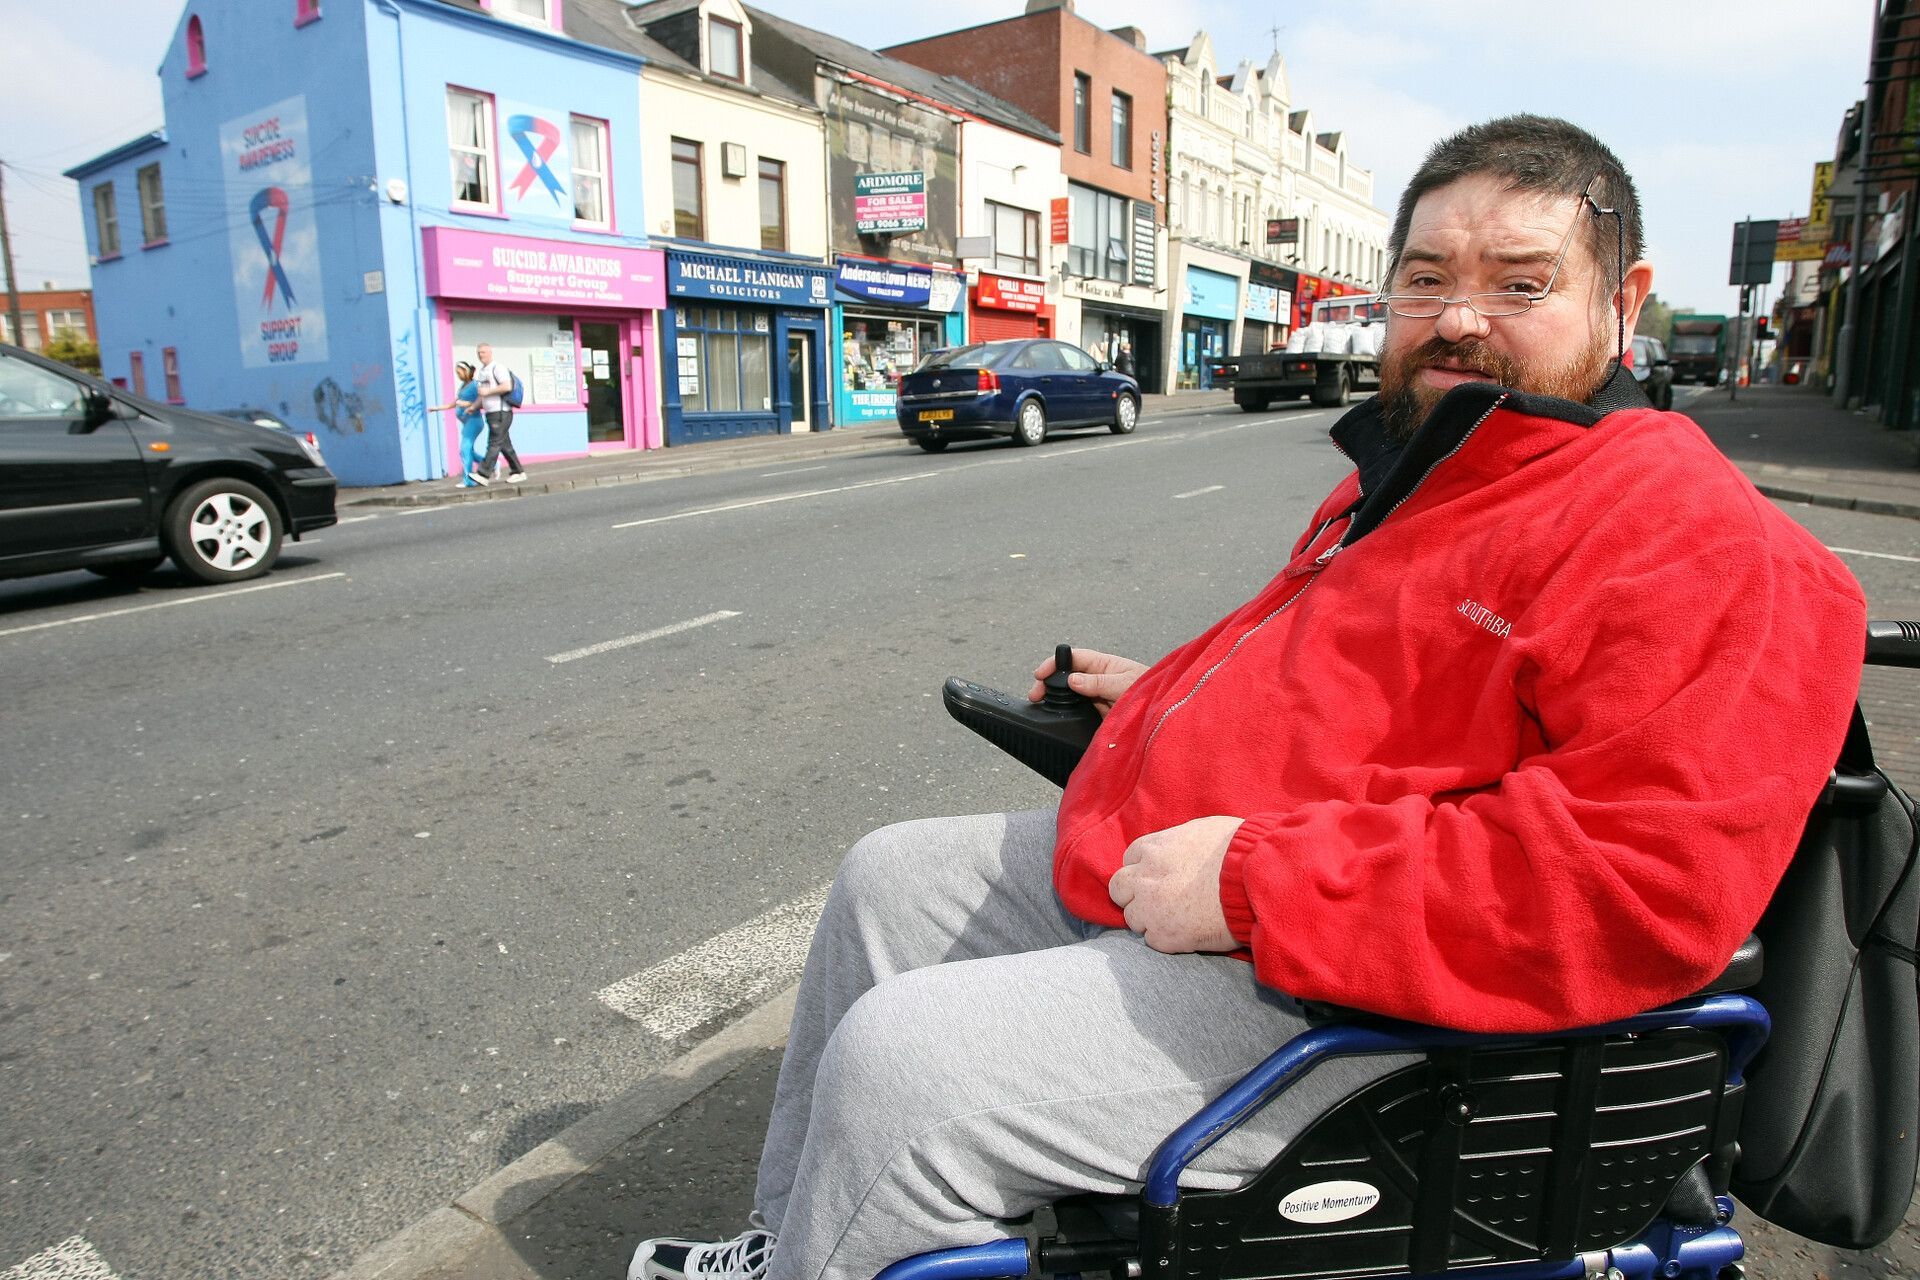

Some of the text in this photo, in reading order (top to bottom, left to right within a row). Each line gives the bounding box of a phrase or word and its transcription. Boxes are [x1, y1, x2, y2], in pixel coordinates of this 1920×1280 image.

[854, 100, 876, 118] heart
[876, 109, 885, 121] of
[885, 111, 897, 125] the
[243, 116, 280, 148] SUICIDE
[239, 137, 295, 172] AWARENESS
[858, 174, 923, 188] ARDMORE
[867, 195, 913, 206] FOR SALE
[1814, 163, 1828, 222] TAXI
[858, 220, 874, 229] 028
[492, 247, 547, 271] SUICIDE
[549, 252, 622, 278] AWARENESS
[506, 270, 608, 291] Support Group
[680, 262, 804, 289] MICHAEL FLANIGAN
[840, 263, 931, 290] Andersonstown NEWS
[709, 284, 781, 300] SOLICITORS
[998, 278, 1045, 297] CHILLI CHILLI
[260, 317, 302, 341] SUPPORT
[268, 341, 298, 363] GROUP
[852, 393, 870, 406] THE
[1284, 1200, 1320, 1214] Positive
